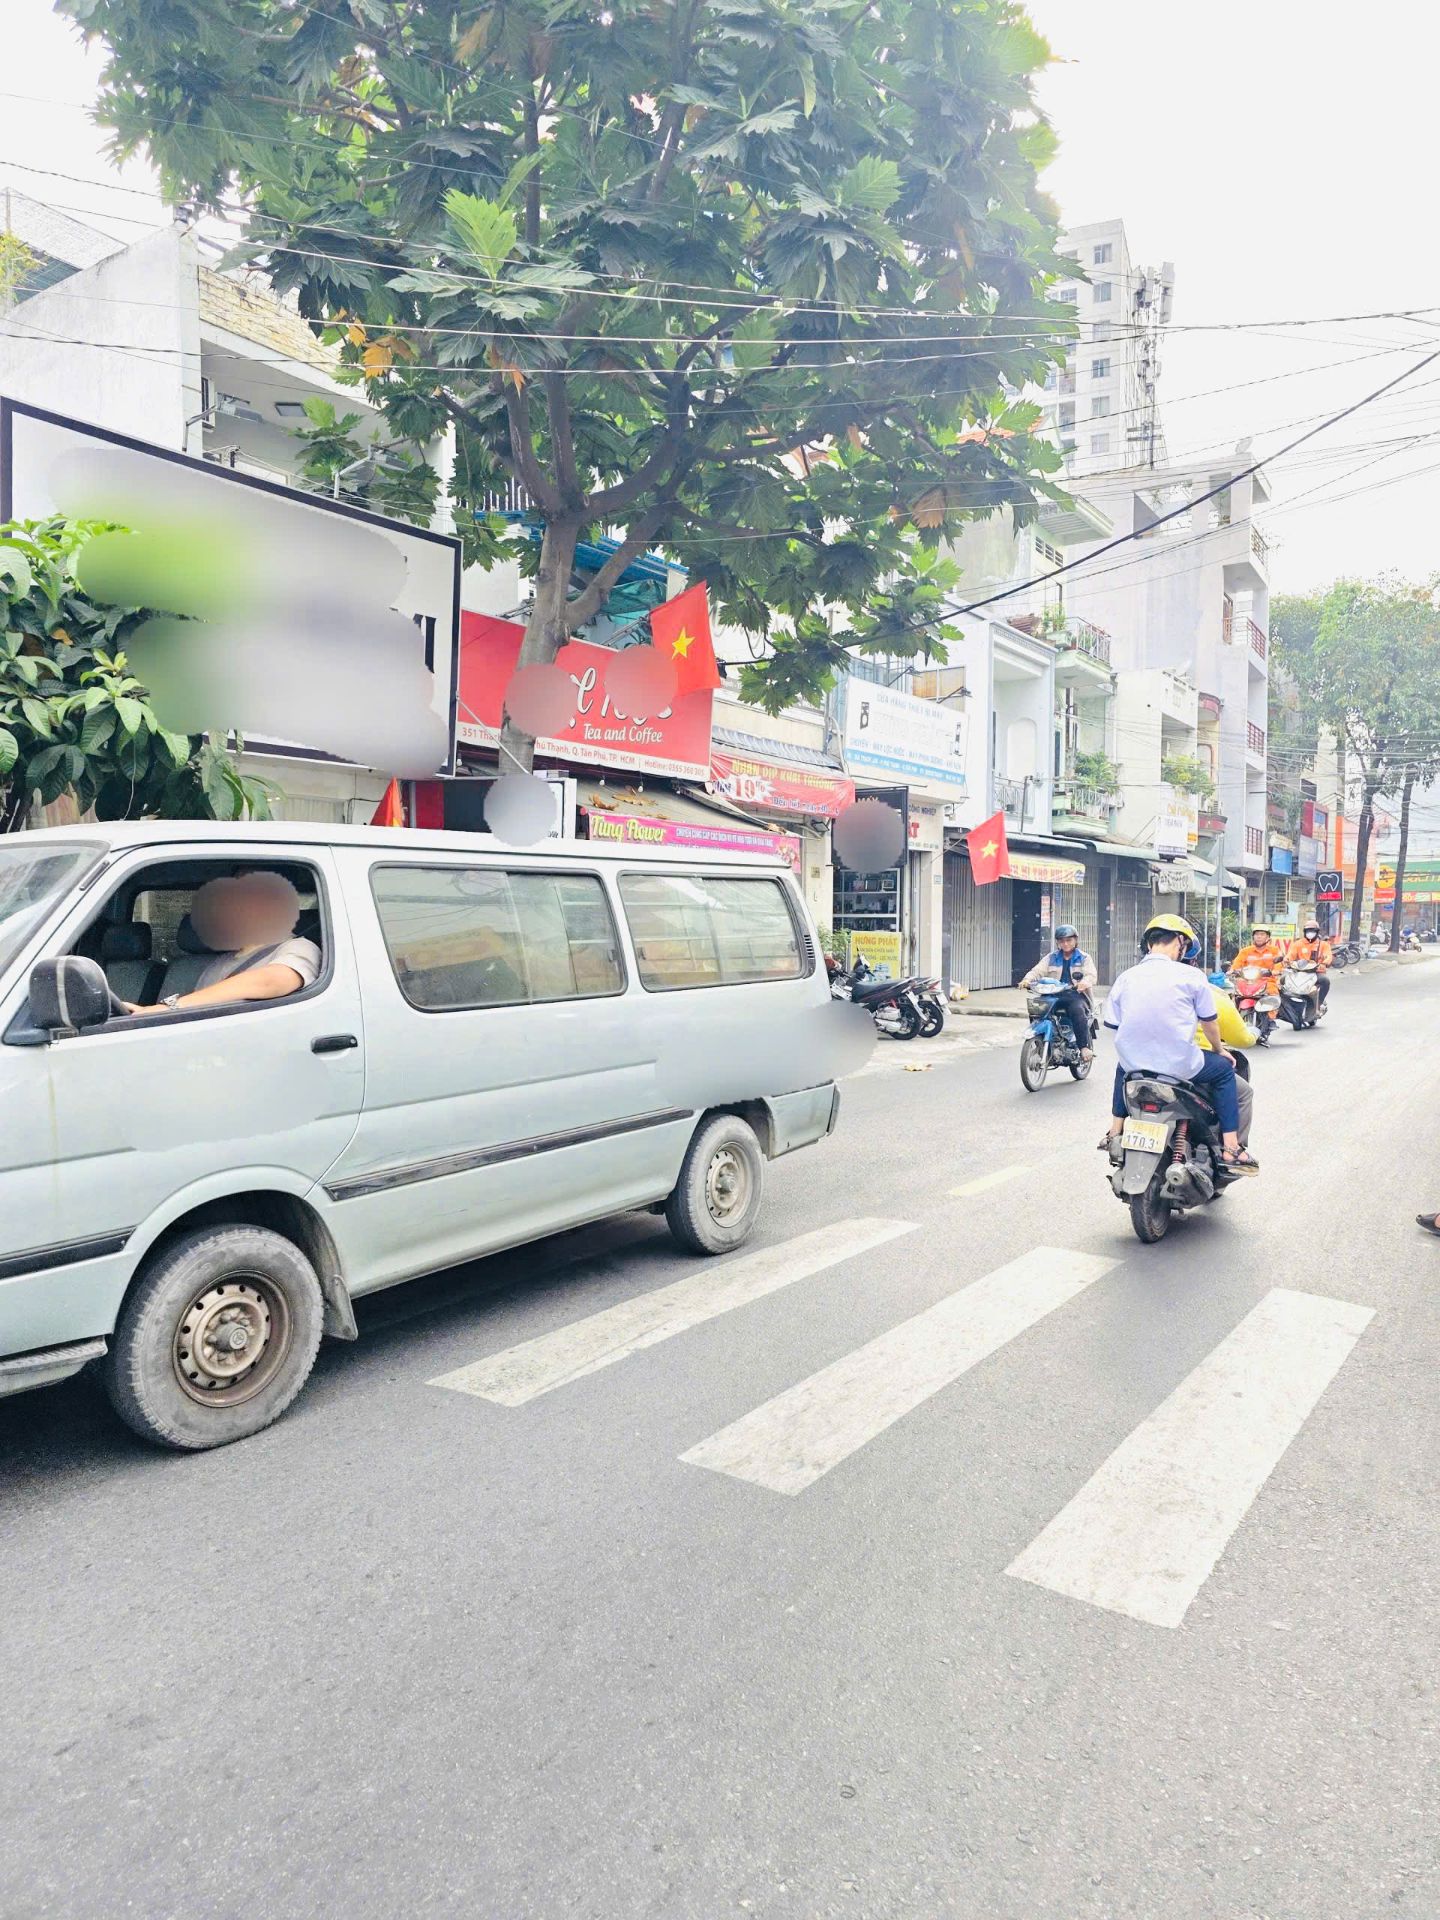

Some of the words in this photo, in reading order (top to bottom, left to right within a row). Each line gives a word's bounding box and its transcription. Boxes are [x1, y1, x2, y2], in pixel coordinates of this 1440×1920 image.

[462, 727, 477, 738] 351
[572, 746, 580, 757] Q.
[581, 747, 592, 758] Tân
[620, 754, 635, 764] HCM
[584, 723, 601, 740] Tea
[604, 727, 626, 741] and
[629, 727, 663, 744] Coffee
[626, 818, 667, 842] Flower
